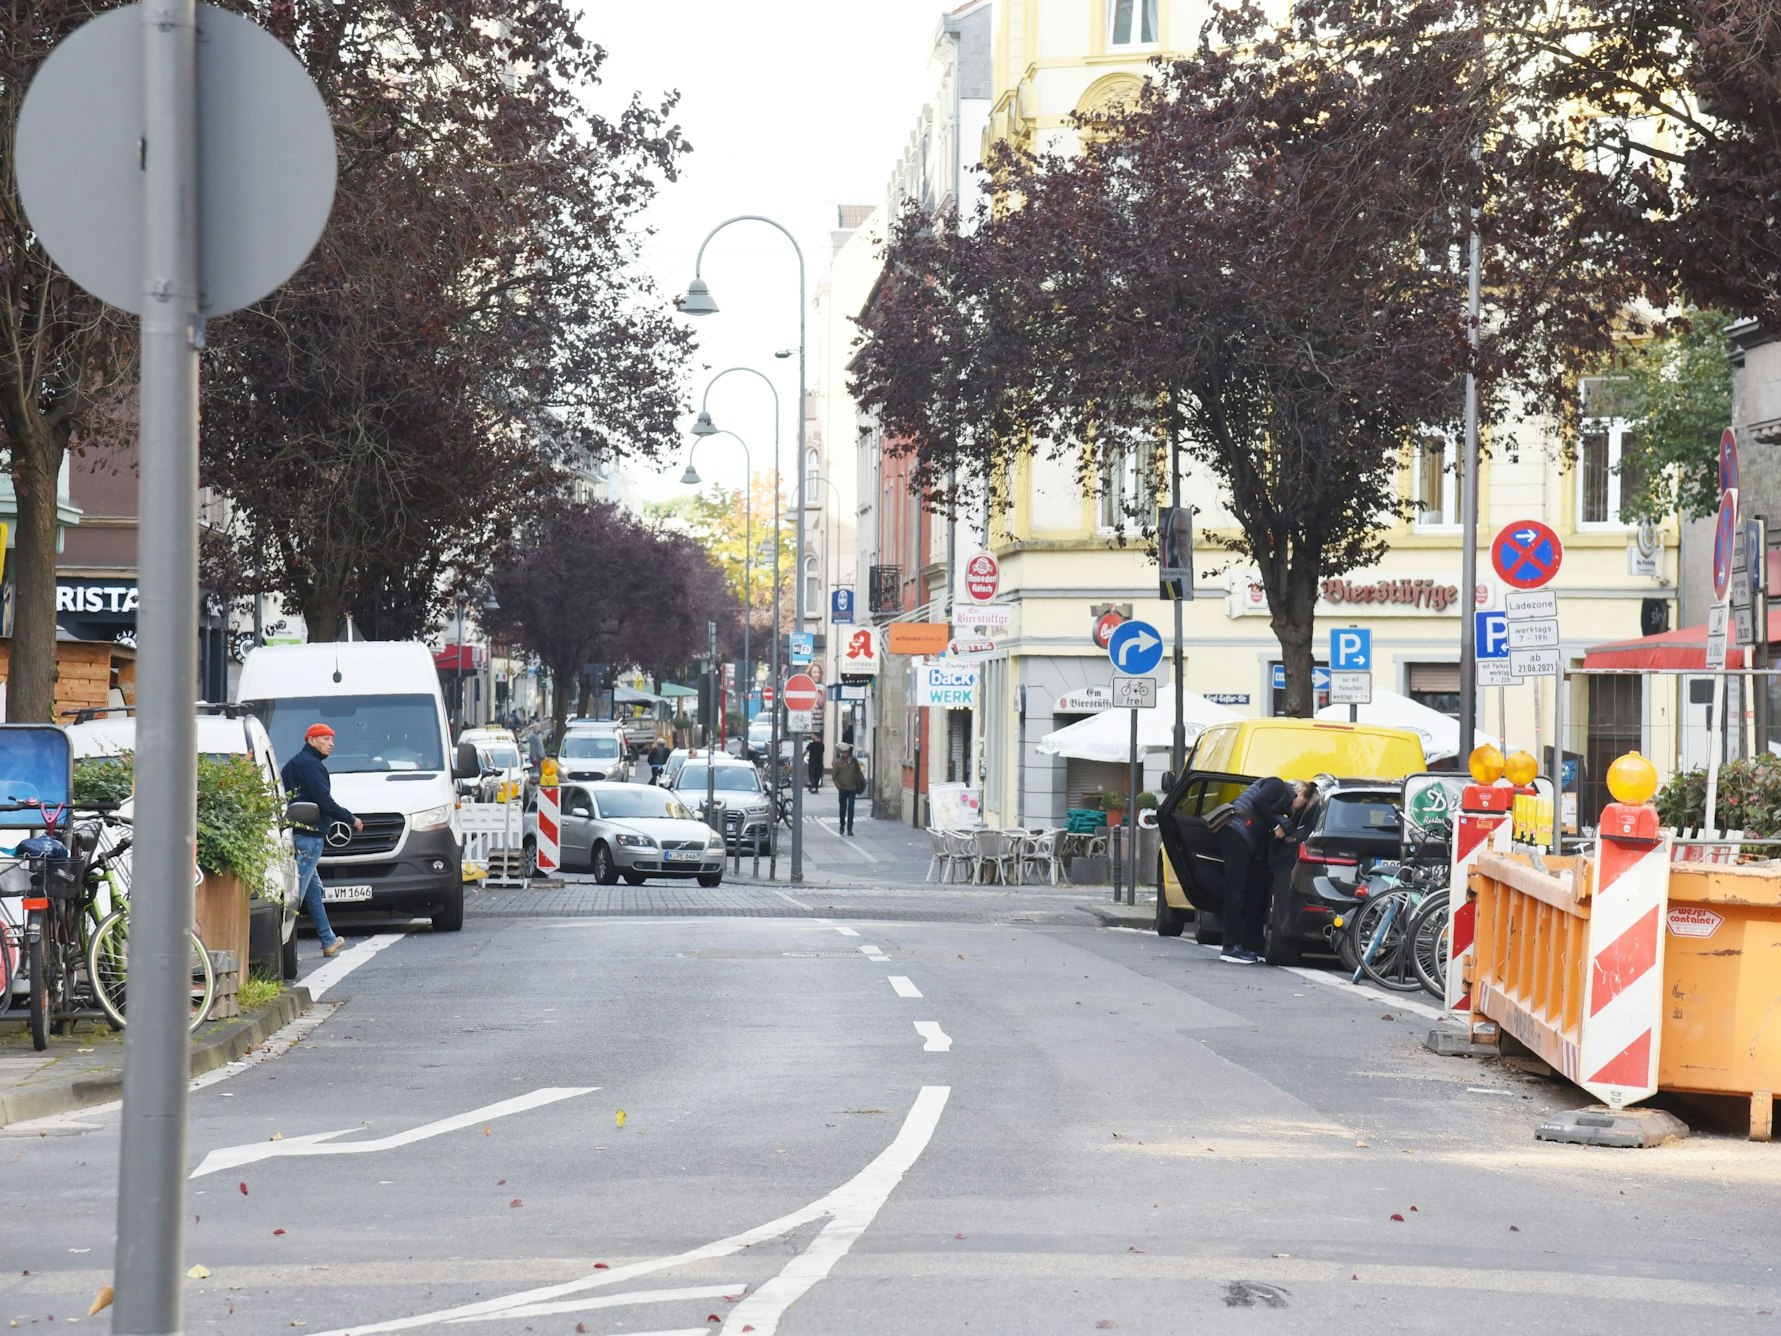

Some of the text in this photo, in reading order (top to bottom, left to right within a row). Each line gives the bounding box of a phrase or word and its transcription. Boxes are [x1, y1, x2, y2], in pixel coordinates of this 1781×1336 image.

[1509, 601, 1553, 610] Ladezone
[1486, 616, 1507, 653] P
[1515, 626, 1552, 635] werktags
[1339, 633, 1362, 666] P
[1518, 663, 1554, 673] 21.06.2021
[930, 670, 974, 685] back
[930, 690, 972, 703] WERK
[1126, 697, 1143, 705] frei
[335, 887, 371, 898] VM 1646
[1678, 908, 1706, 917] weser
[1670, 915, 1715, 925] container
